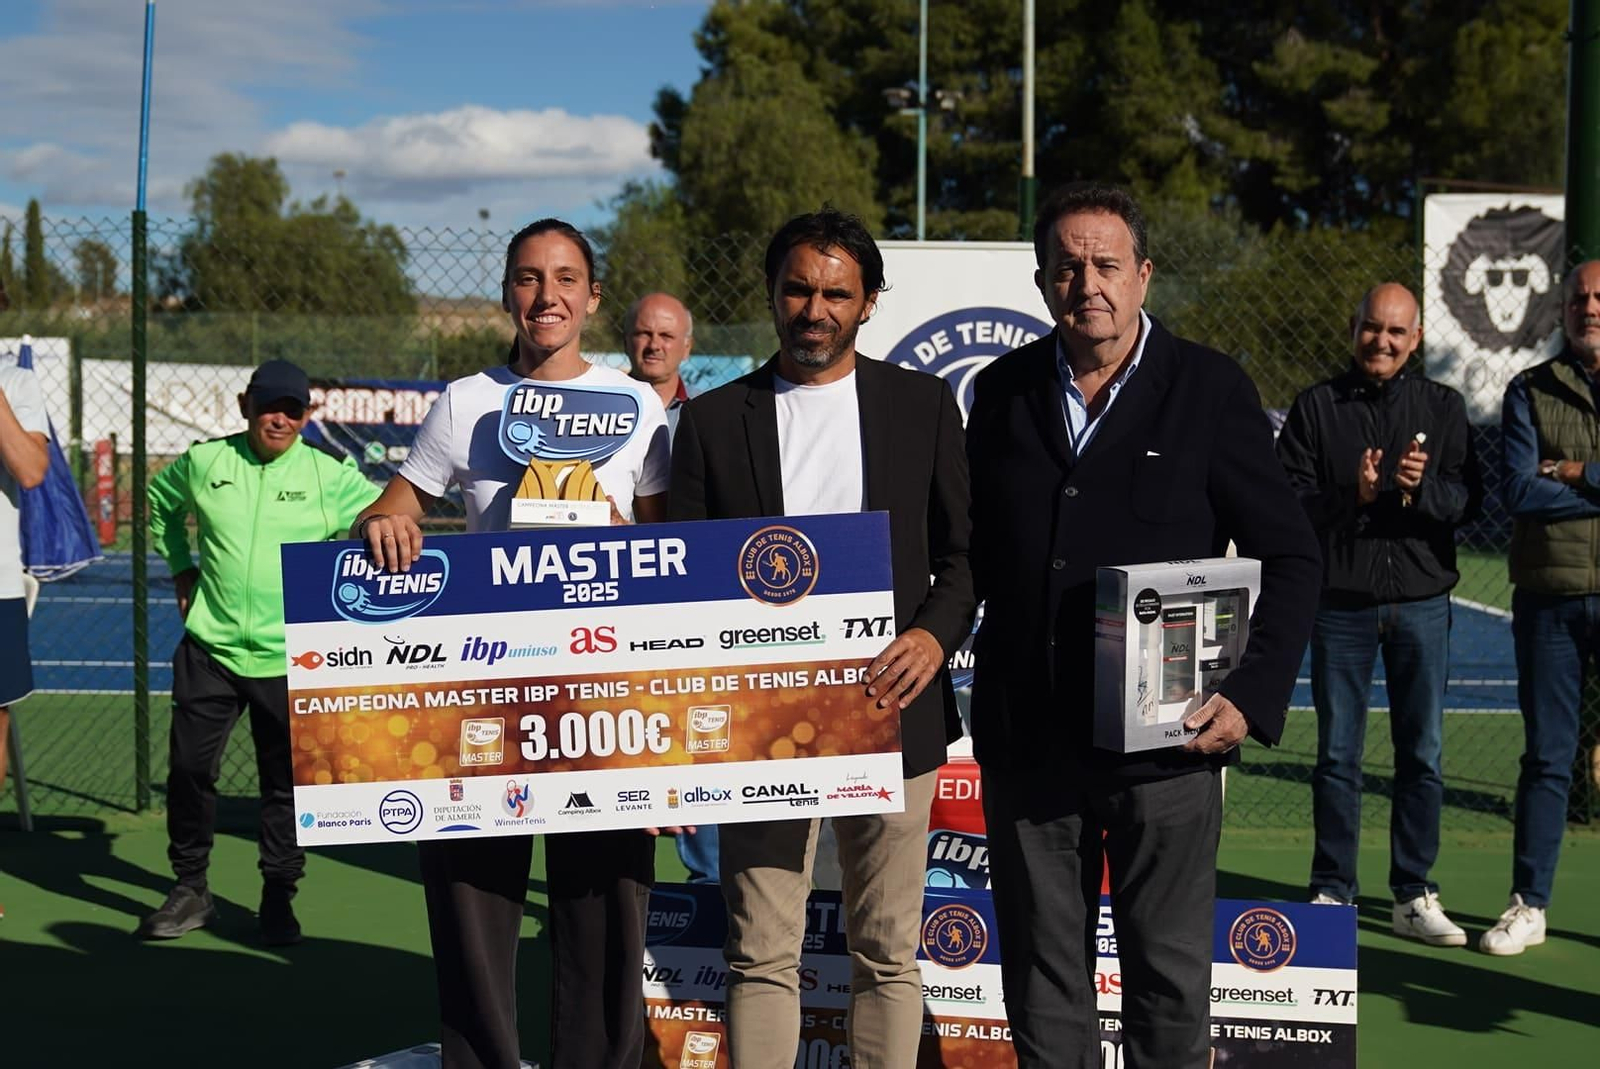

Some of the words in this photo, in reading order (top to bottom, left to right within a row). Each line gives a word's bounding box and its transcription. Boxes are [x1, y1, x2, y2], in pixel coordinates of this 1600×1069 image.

[914, 330, 953, 366] DE
[955, 321, 1040, 349] TENIS
[512, 389, 563, 418] ibp
[555, 413, 635, 435] TENIS
[745, 547, 758, 569] CLUB
[755, 537, 767, 548] DE
[768, 533, 793, 543] TENIS
[793, 541, 811, 566] ALBOX
[342, 554, 382, 580] ibp
[491, 538, 687, 585] MASTER
[376, 573, 442, 595] TENIS
[1187, 575, 1206, 585] NDL
[563, 582, 619, 603] 2025
[719, 621, 821, 650] greenset
[842, 616, 893, 639] TXT
[569, 625, 618, 655] as
[630, 637, 705, 652] HEAD
[1172, 644, 1190, 653] NDL
[326, 646, 373, 667] sidn
[386, 643, 447, 665] NDL
[460, 636, 508, 665] ibp
[508, 644, 557, 658] uniuso
[294, 692, 420, 715] CAMPEONA
[424, 687, 519, 708] MASTER
[524, 685, 559, 702] IBP
[565, 681, 629, 700] TENIS
[650, 676, 706, 695] CLUB
[711, 674, 739, 692] DE
[745, 670, 809, 690] TENIS
[694, 711, 708, 719] ibp
[468, 724, 482, 732] ibp
[519, 709, 671, 761] 3.000€
[1165, 730, 1182, 738] PACK
[688, 739, 728, 750] MASTER
[462, 752, 502, 763] MASTER
[617, 790, 650, 802] SER
[684, 786, 732, 803] albox
[836, 784, 873, 792] MARÍA
[838, 791, 879, 799] VILLOTA
[433, 804, 482, 814] DIPUTACIÓN
[790, 797, 819, 807] tenis
[317, 810, 362, 819] Fundación
[382, 807, 413, 818] PTPA
[435, 814, 446, 822] DE
[447, 812, 482, 822] ALMERÍA
[318, 820, 347, 828] Blanco
[349, 818, 372, 827] Paris
[494, 817, 546, 827] WinnerTenis
[932, 835, 989, 870] ibp
[648, 911, 690, 927] ENIS
[928, 919, 939, 936] CLUB
[949, 911, 969, 919] TENIS
[1235, 923, 1247, 941] CLUB
[1255, 914, 1276, 923] TENIS
[802, 934, 825, 949] 25
[642, 966, 683, 983] NDL
[922, 985, 982, 1001] eenset
[1210, 986, 1294, 1003] greenset
[1313, 988, 1355, 1006] TXT
[654, 1005, 726, 1023] MASTER
[922, 1022, 962, 1037] ENIS
[965, 1024, 1013, 1042] ALBO
[1223, 1024, 1272, 1041] TENIS
[1274, 1027, 1332, 1044] ALBOX
[681, 1059, 714, 1068] MASTER
